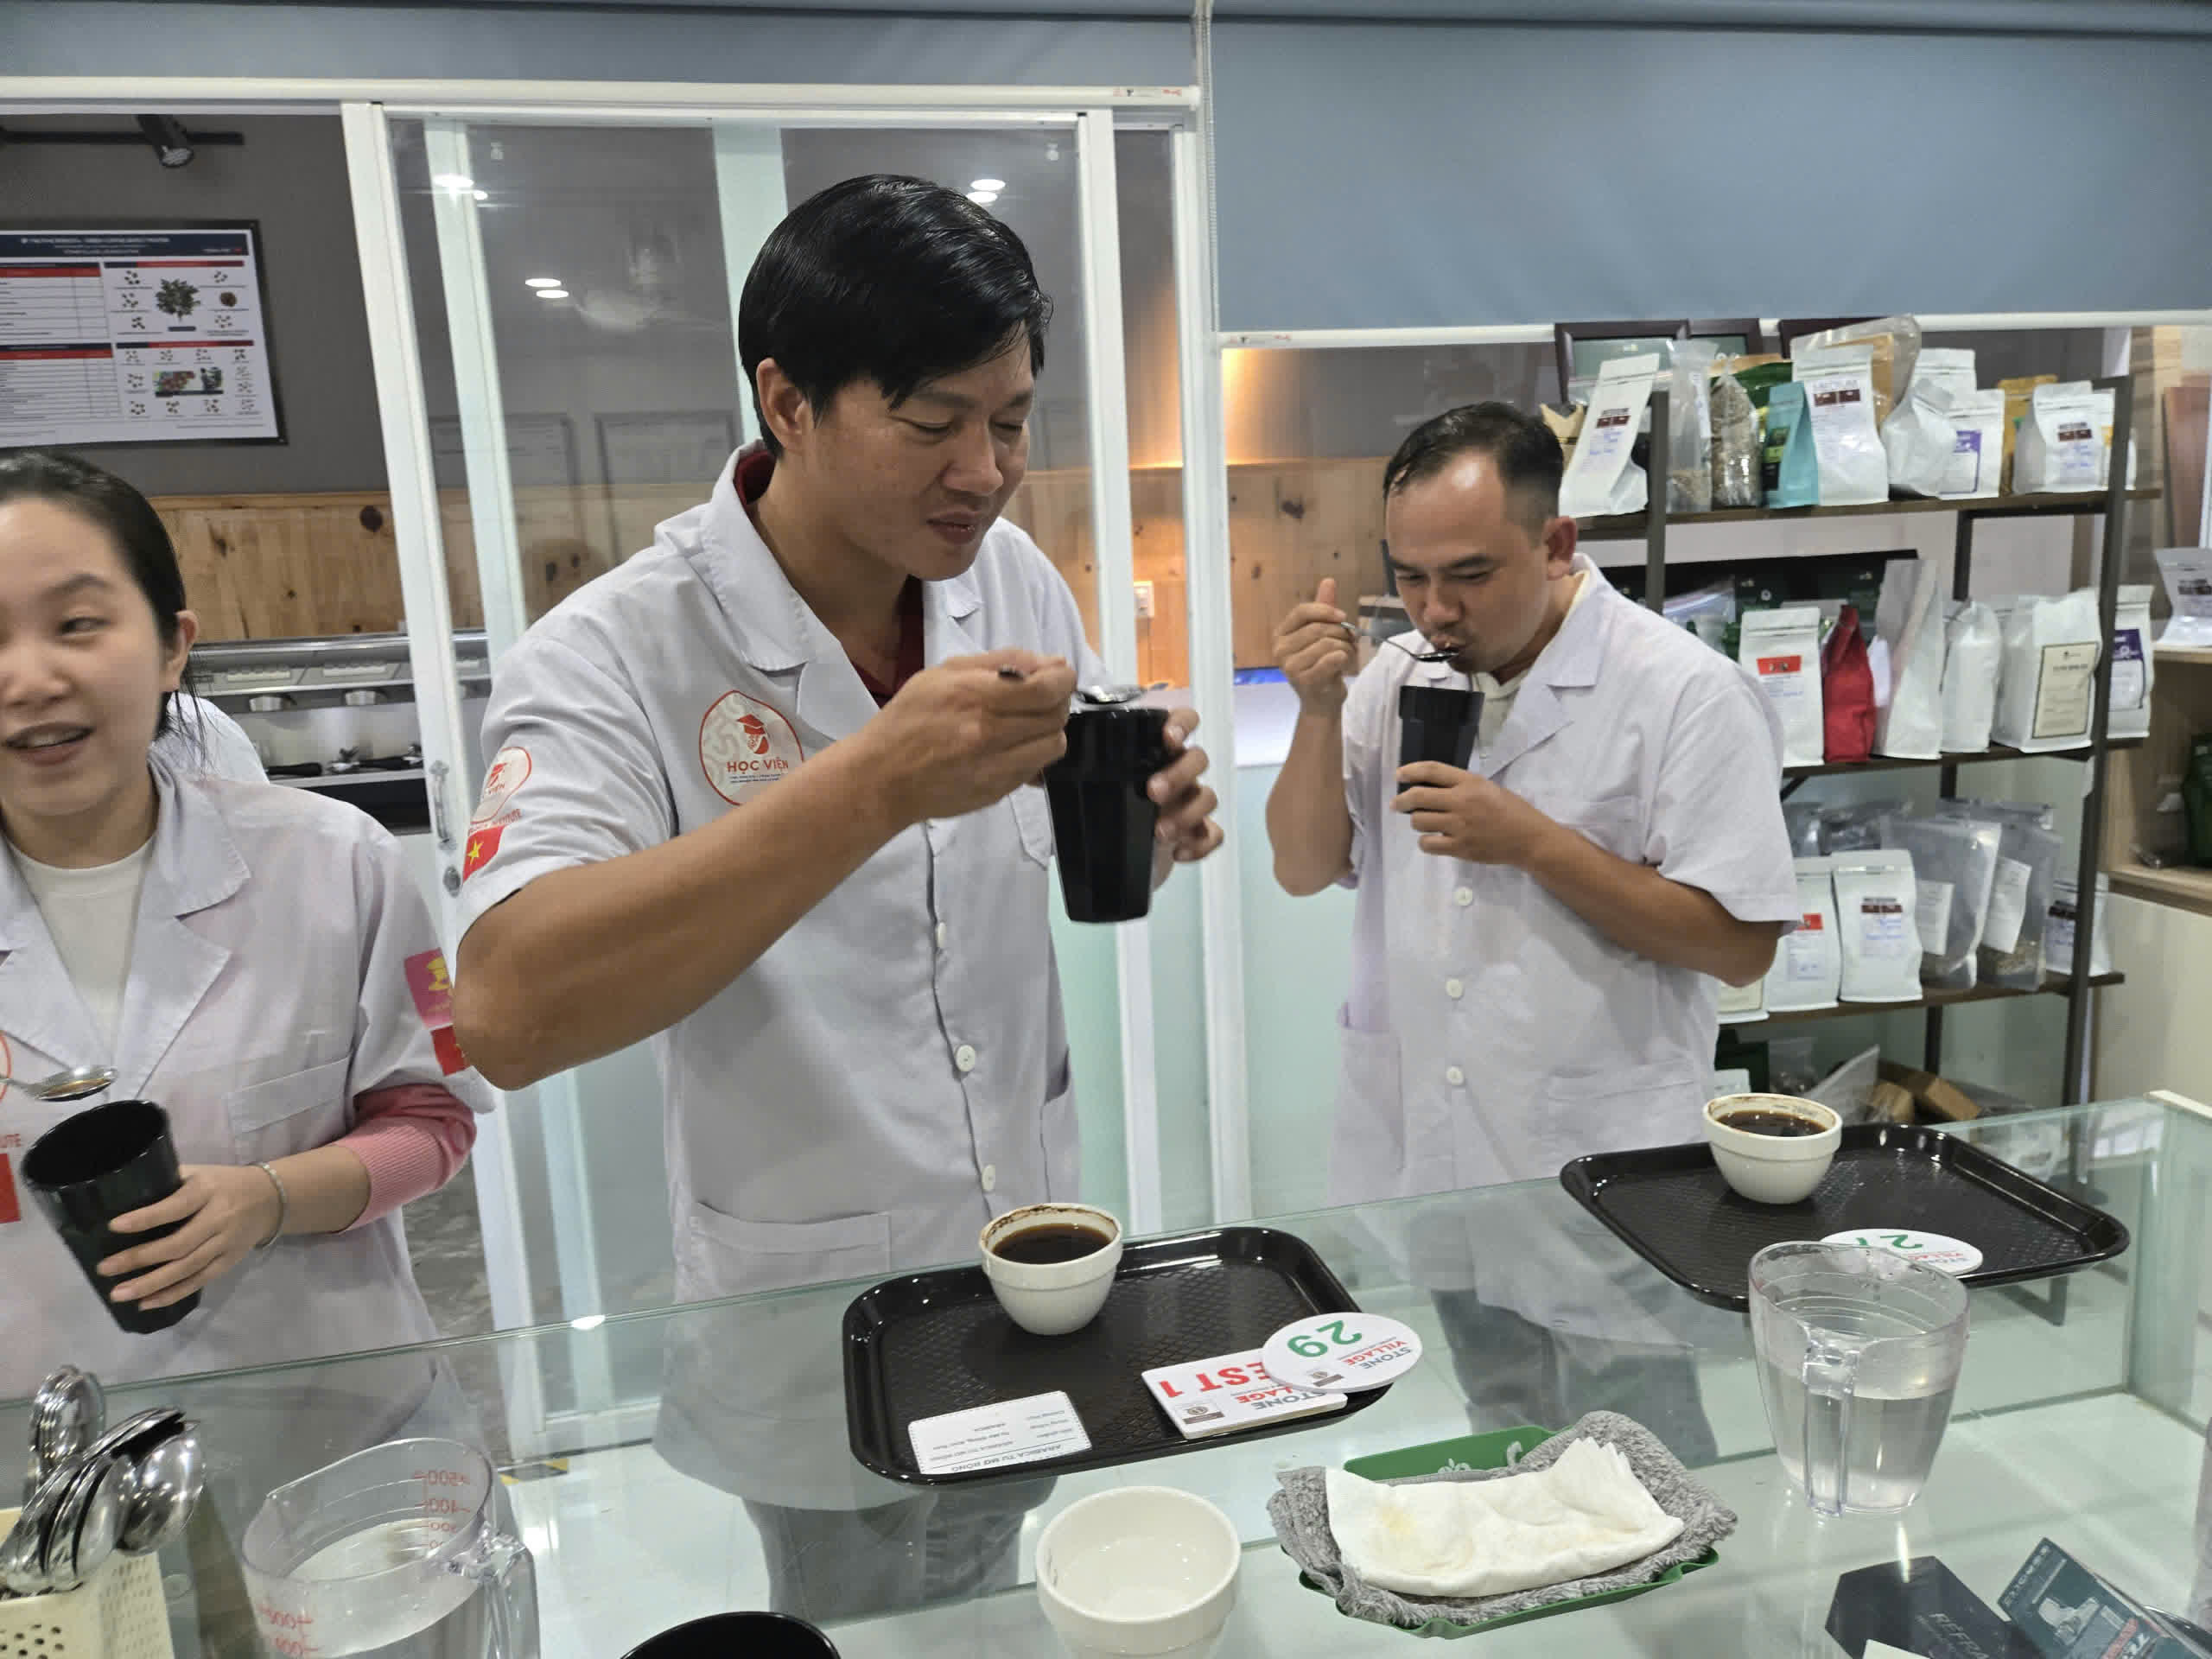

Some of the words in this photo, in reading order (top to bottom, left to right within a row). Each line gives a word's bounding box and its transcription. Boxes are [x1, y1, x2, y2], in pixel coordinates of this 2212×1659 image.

[727, 760, 760, 774] HỌC
[1287, 1319, 1363, 1358] 29
[1341, 1340, 1408, 1366] VILLAGE
[1359, 1346, 1412, 1370] STONE
[1195, 1361, 1271, 1392] EST
[1159, 1380, 1184, 1398] 1
[1234, 1384, 1294, 1404] LAGE
[1250, 1391, 1327, 1410] STONE
